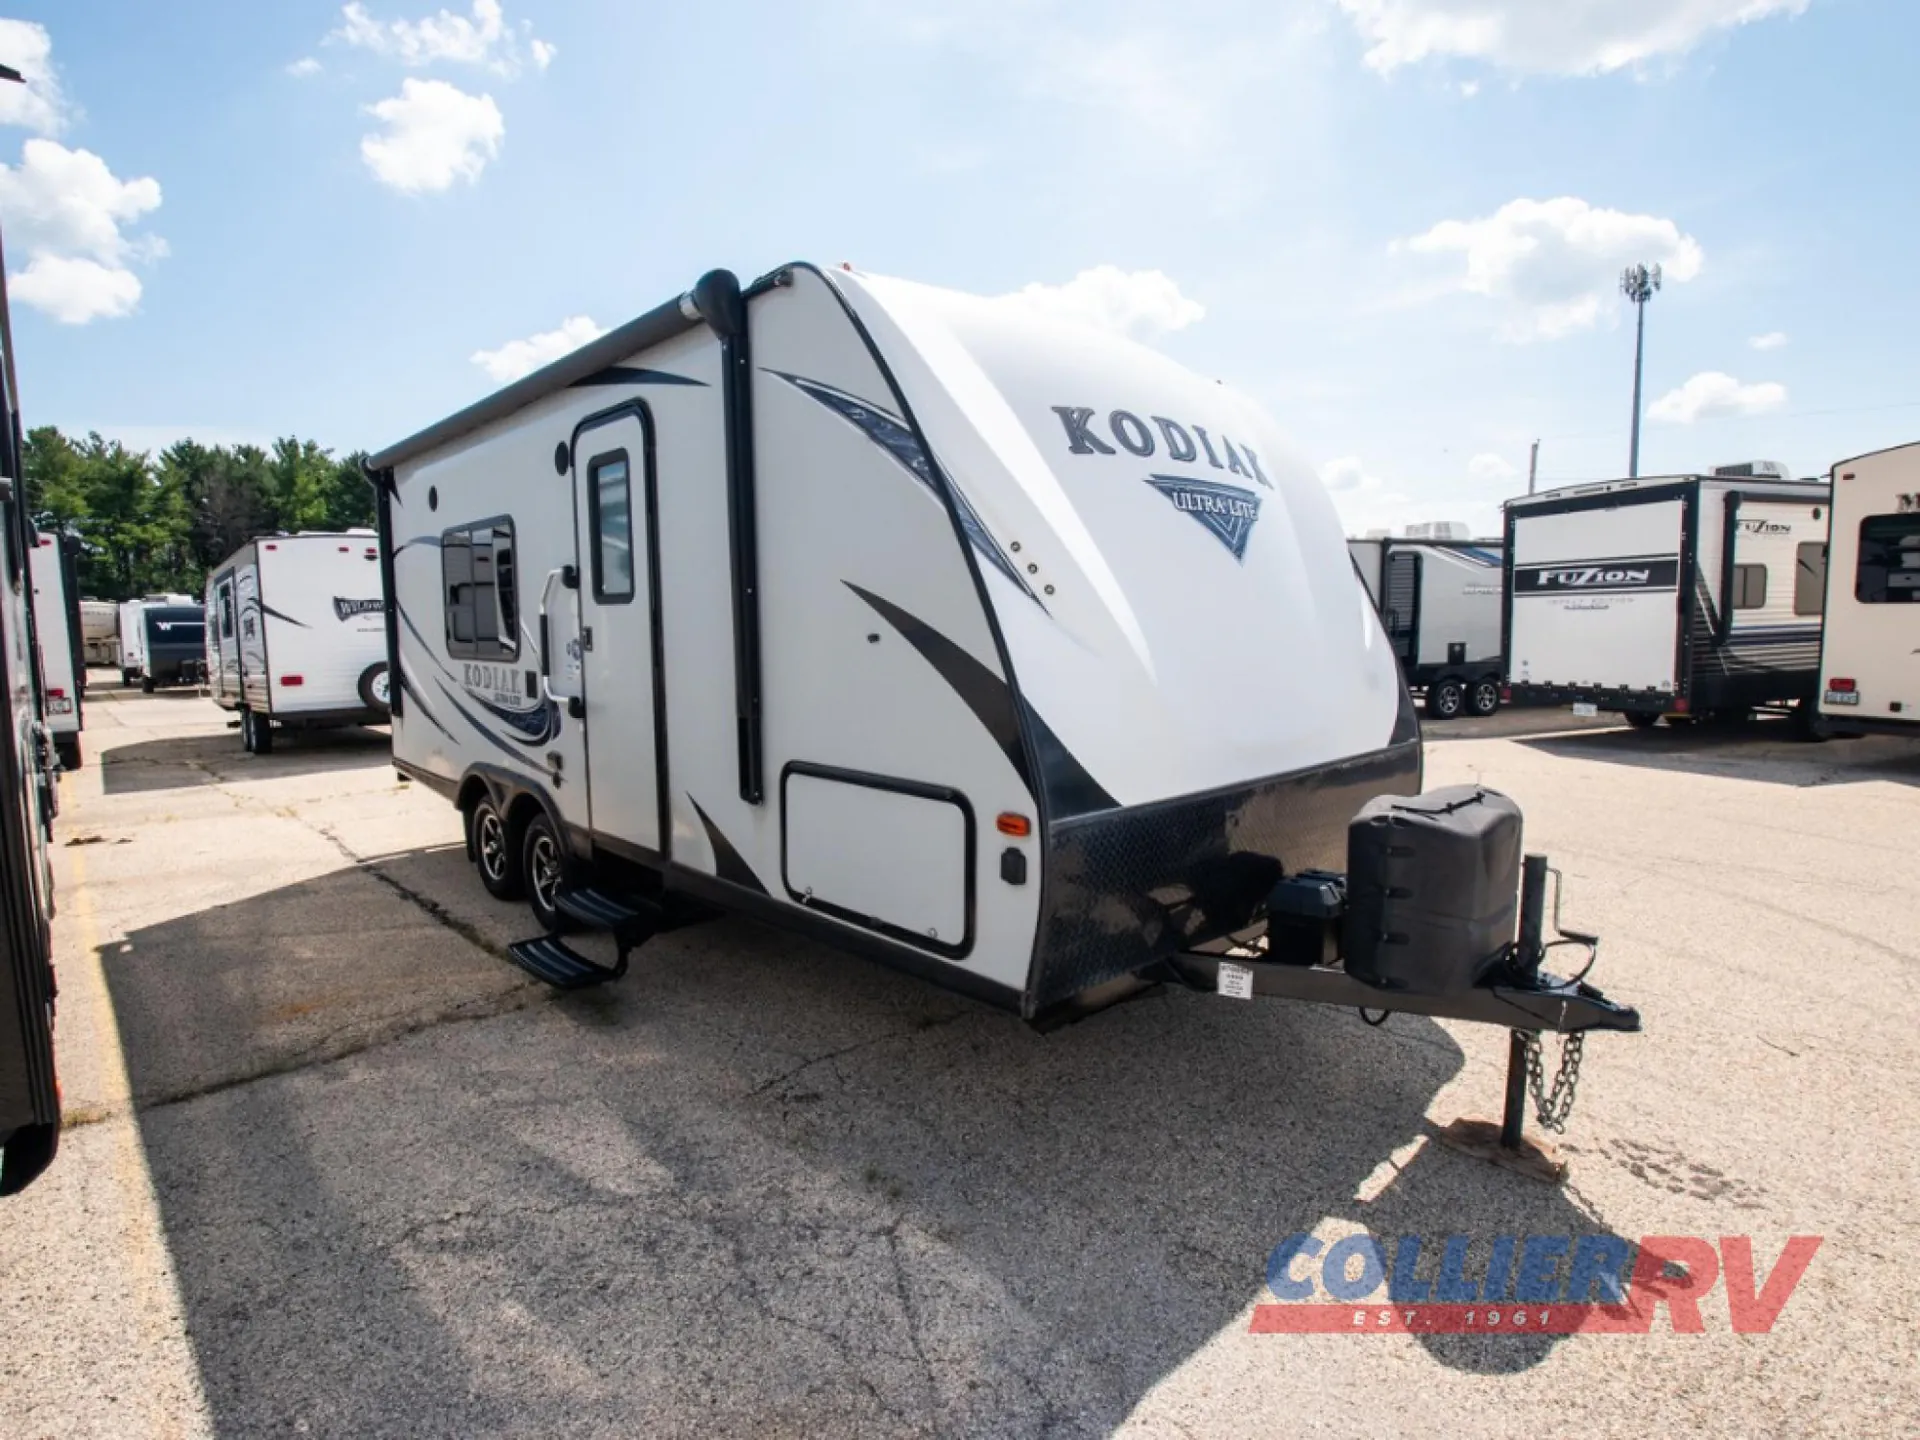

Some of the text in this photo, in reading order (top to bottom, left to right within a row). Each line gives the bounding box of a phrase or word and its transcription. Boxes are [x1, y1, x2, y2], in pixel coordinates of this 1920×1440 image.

[1172, 491, 1229, 515] ULTRA
[1537, 567, 1650, 586] FUZION
[463, 663, 521, 693] KODIAK
